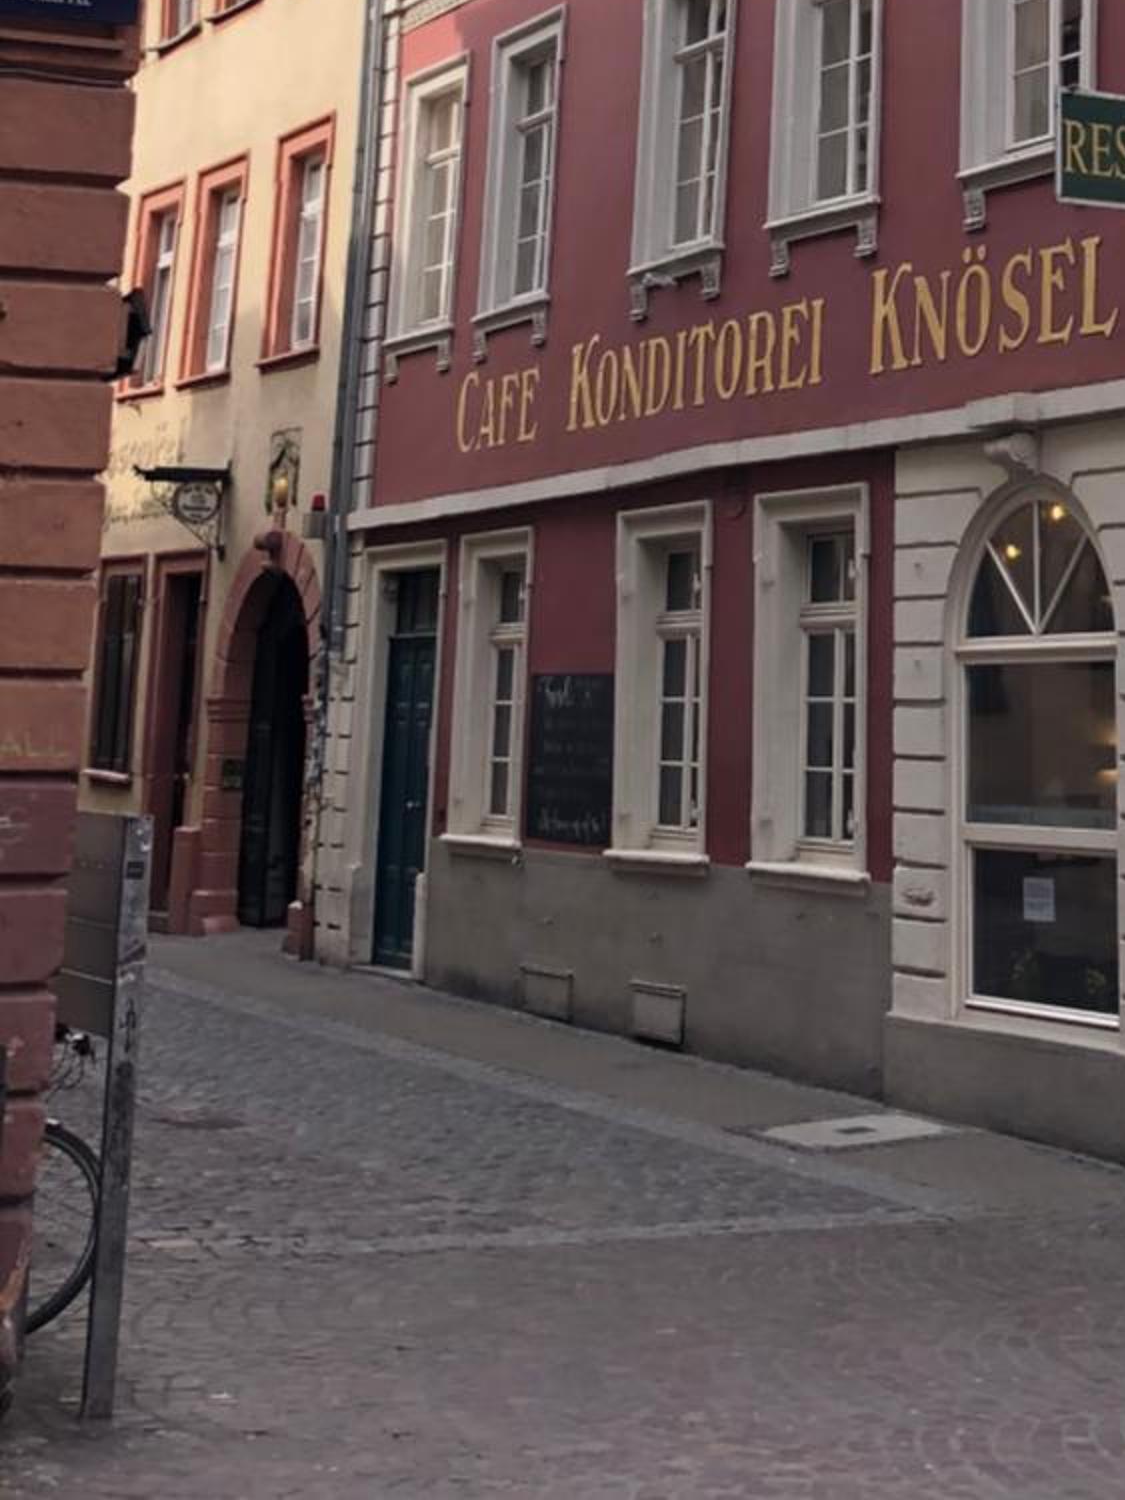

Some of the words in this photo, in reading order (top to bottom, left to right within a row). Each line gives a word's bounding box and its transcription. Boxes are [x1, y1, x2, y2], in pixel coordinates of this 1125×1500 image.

[456, 368, 540, 452] CAFE
[565, 298, 825, 432] KONDITOREI
[869, 236, 1119, 375] KNÖSEL
